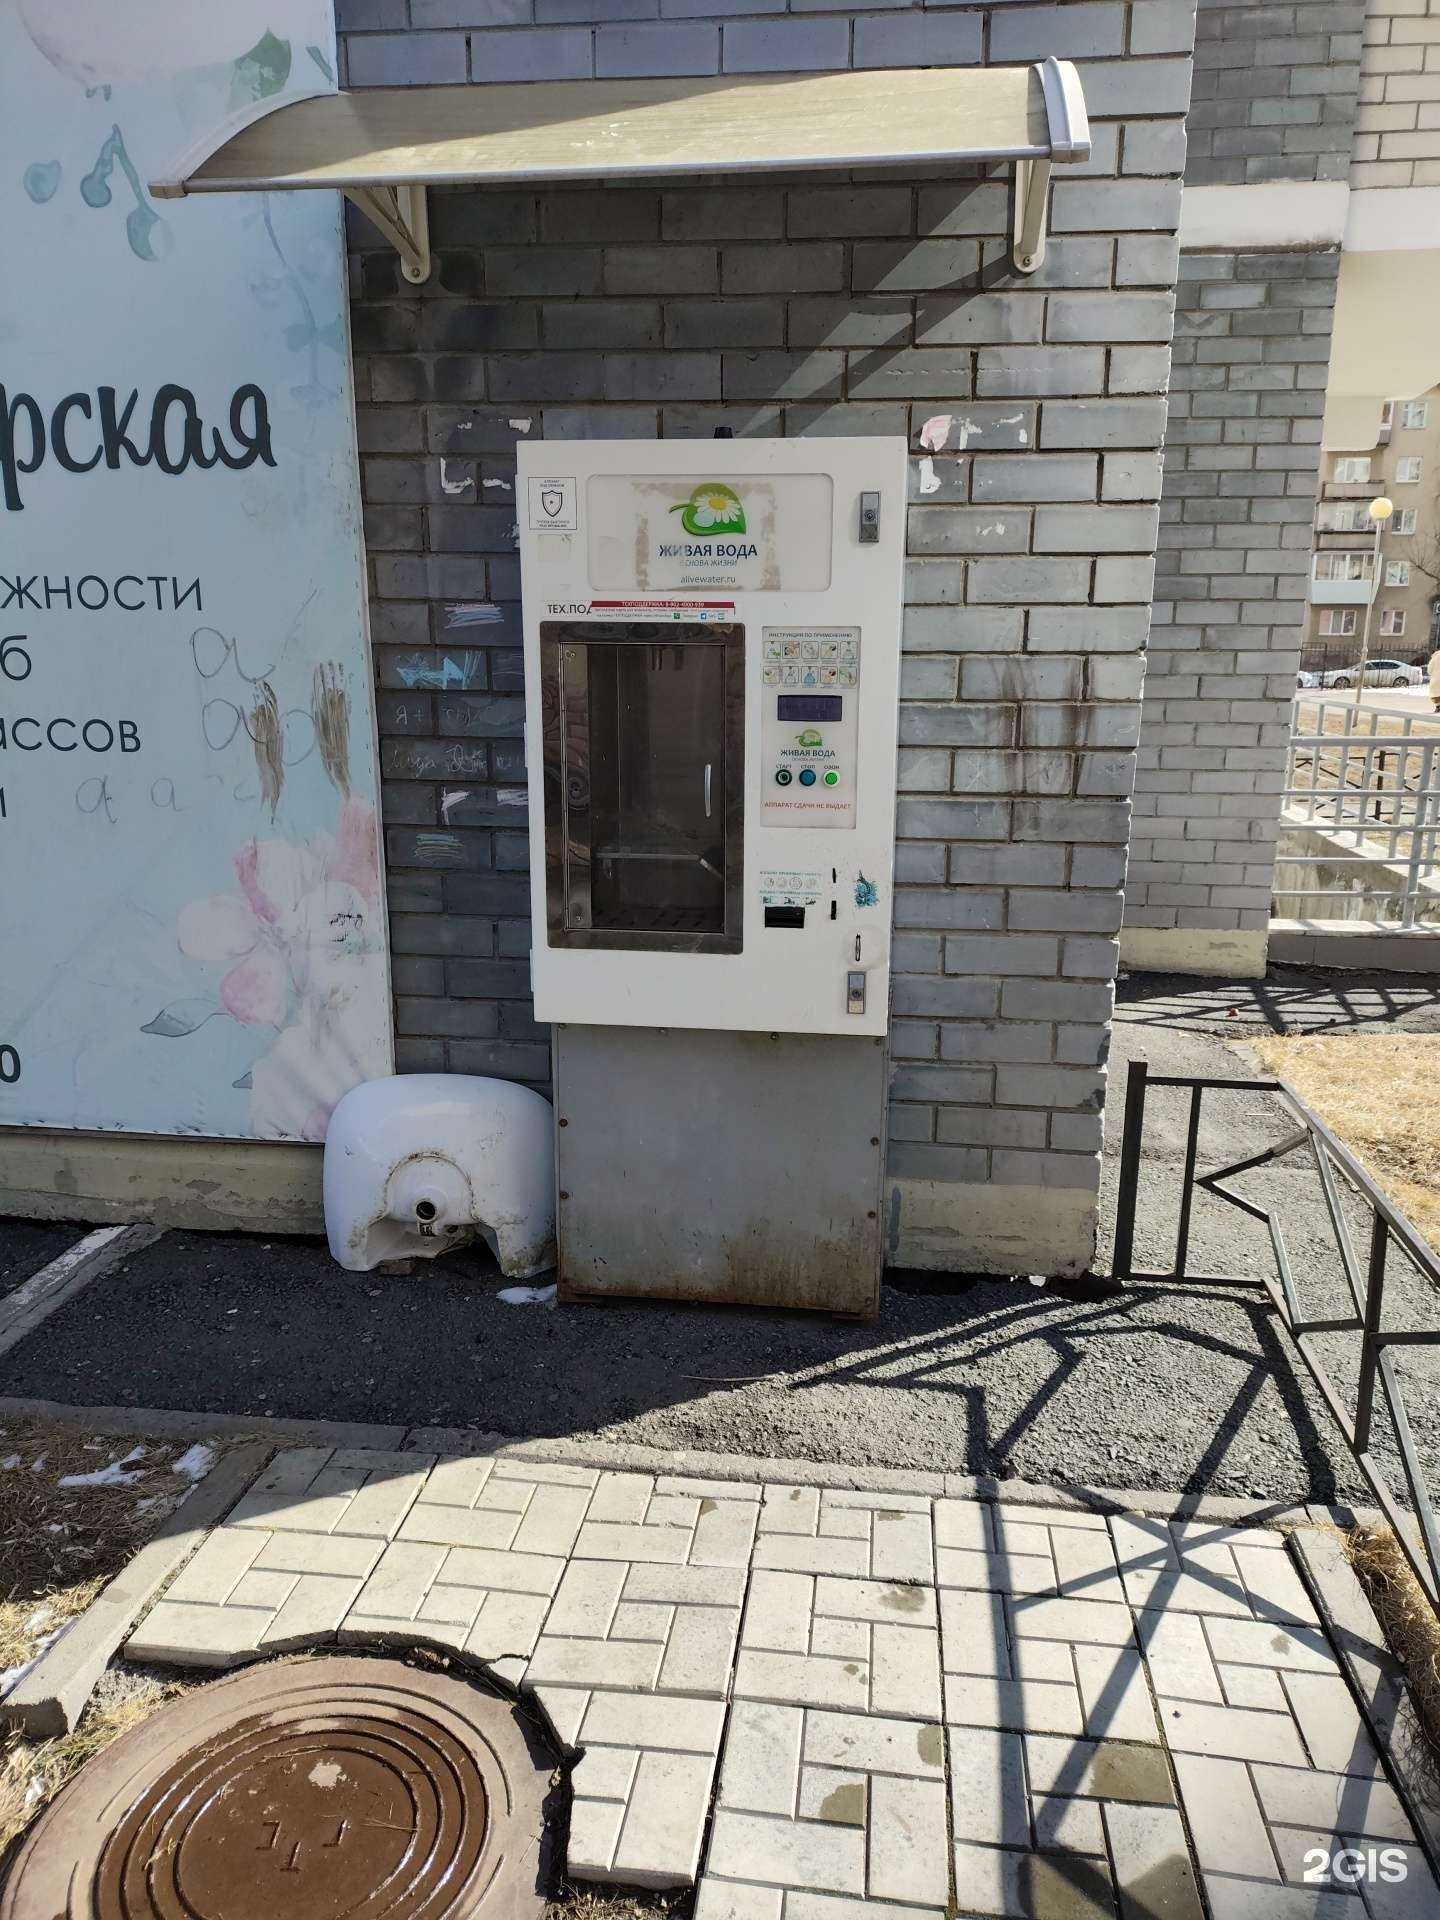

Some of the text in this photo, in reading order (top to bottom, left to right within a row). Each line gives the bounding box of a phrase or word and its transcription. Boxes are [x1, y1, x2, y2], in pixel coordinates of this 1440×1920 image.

[659, 544, 758, 560] ЖИВАЯ ВОДА
[680, 575, 736, 584] alivewater.ru
[0, 717, 141, 753] ссов
[780, 749, 836, 758] ЖИВАЯ ВОДА
